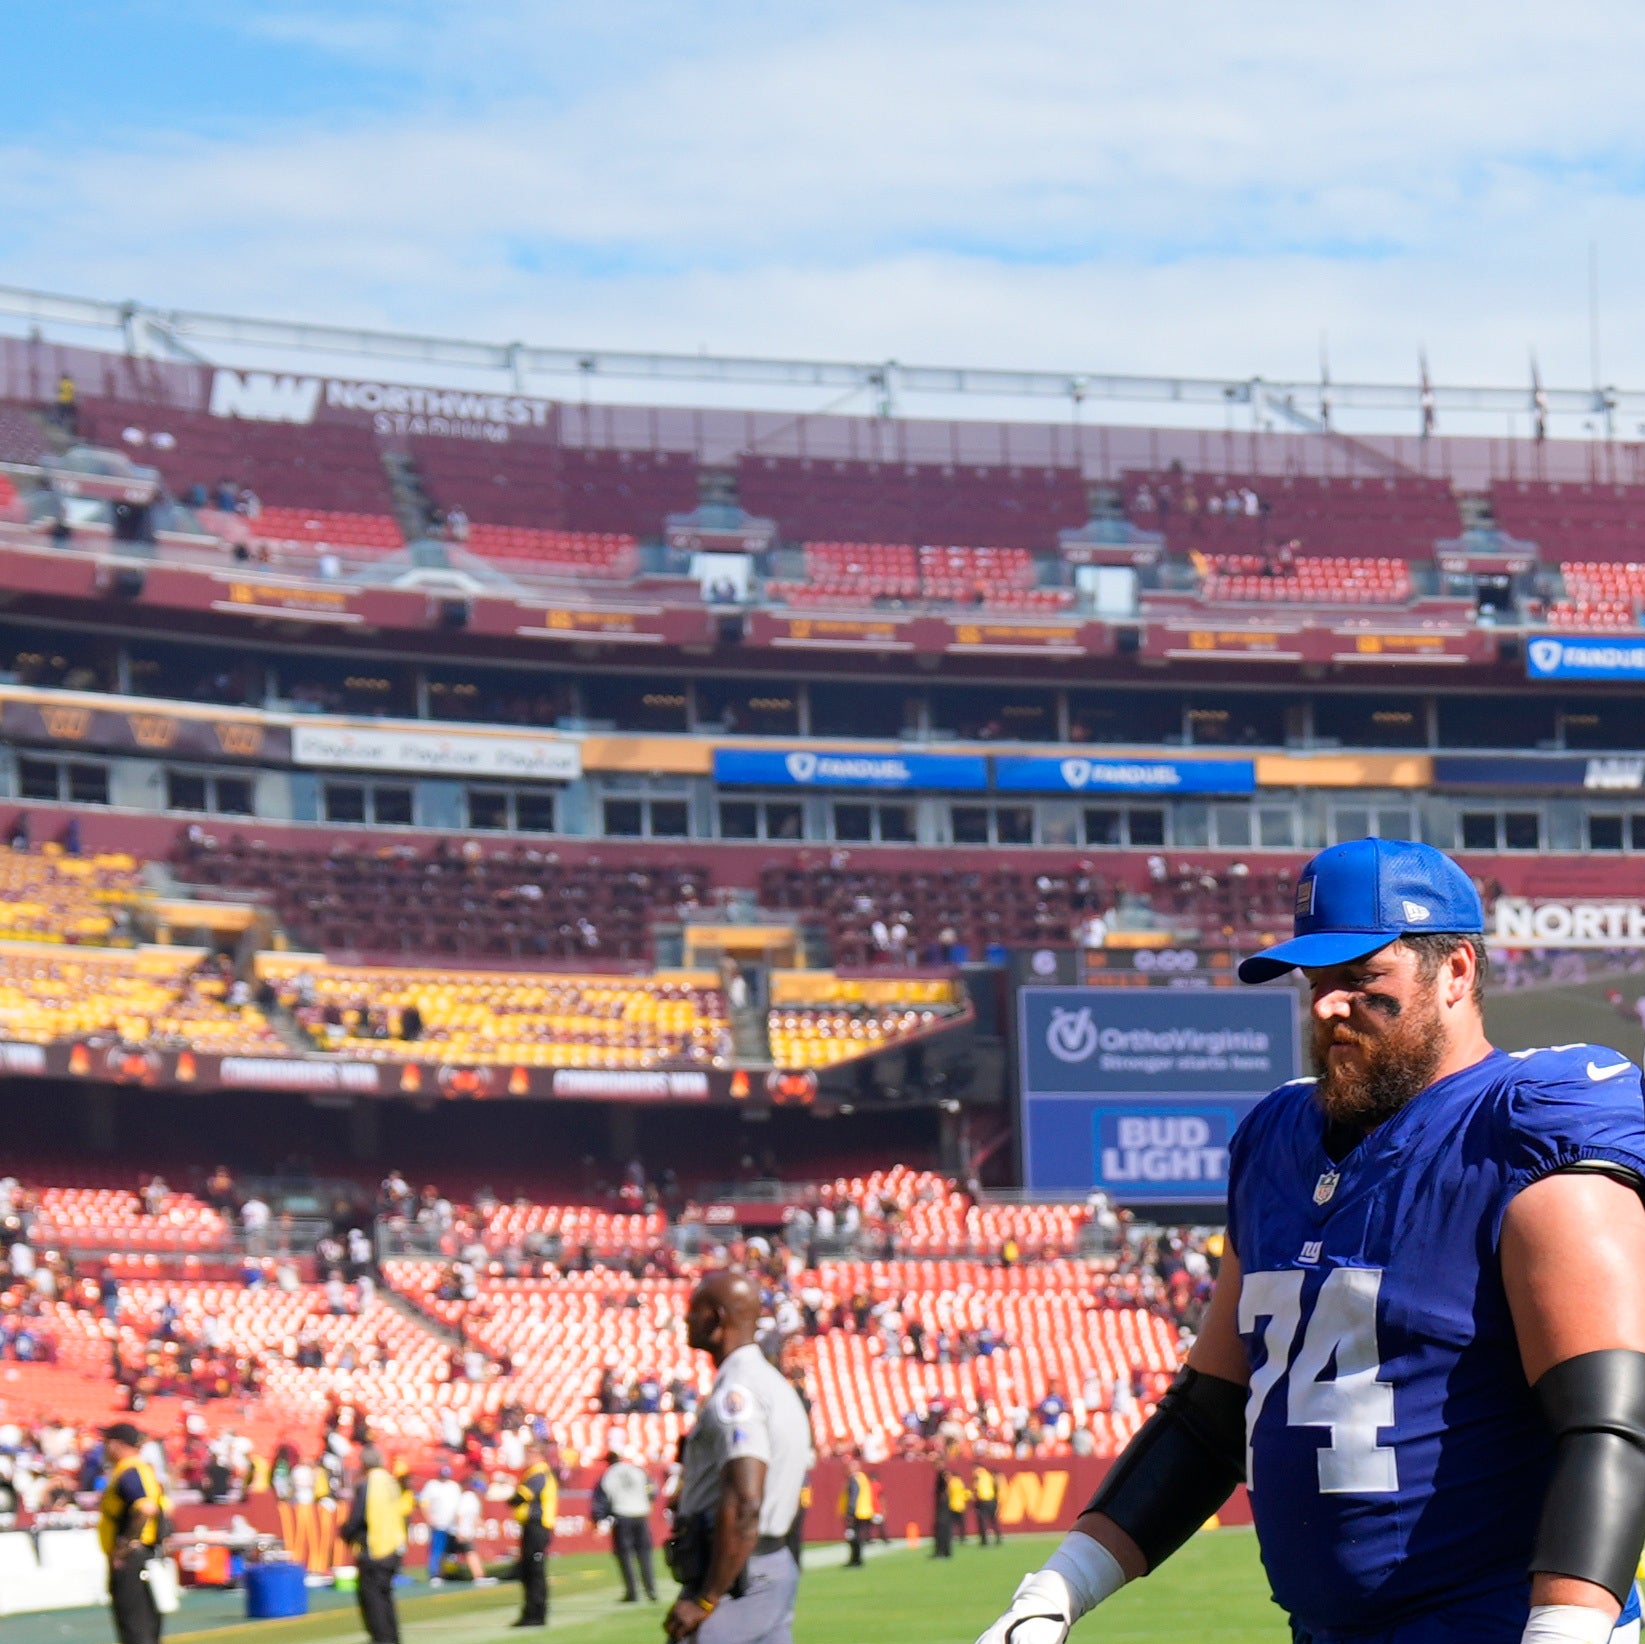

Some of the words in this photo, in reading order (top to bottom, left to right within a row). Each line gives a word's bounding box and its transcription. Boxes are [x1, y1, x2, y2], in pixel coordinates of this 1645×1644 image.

[326, 378, 550, 427] NORTHWEST
[373, 411, 510, 443] STADIUM
[815, 757, 910, 780] FANDUEL
[1090, 763, 1182, 786] FANDUEL
[1032, 949, 1058, 976] 6
[1100, 1027, 1269, 1055] OrthoVirginia
[1100, 1055, 1174, 1074] Stronger
[1118, 1116, 1210, 1150] BUD
[1102, 1149, 1229, 1181] LIGHT
[1237, 1268, 1399, 1495] 74
[996, 1469, 1070, 1525] W
